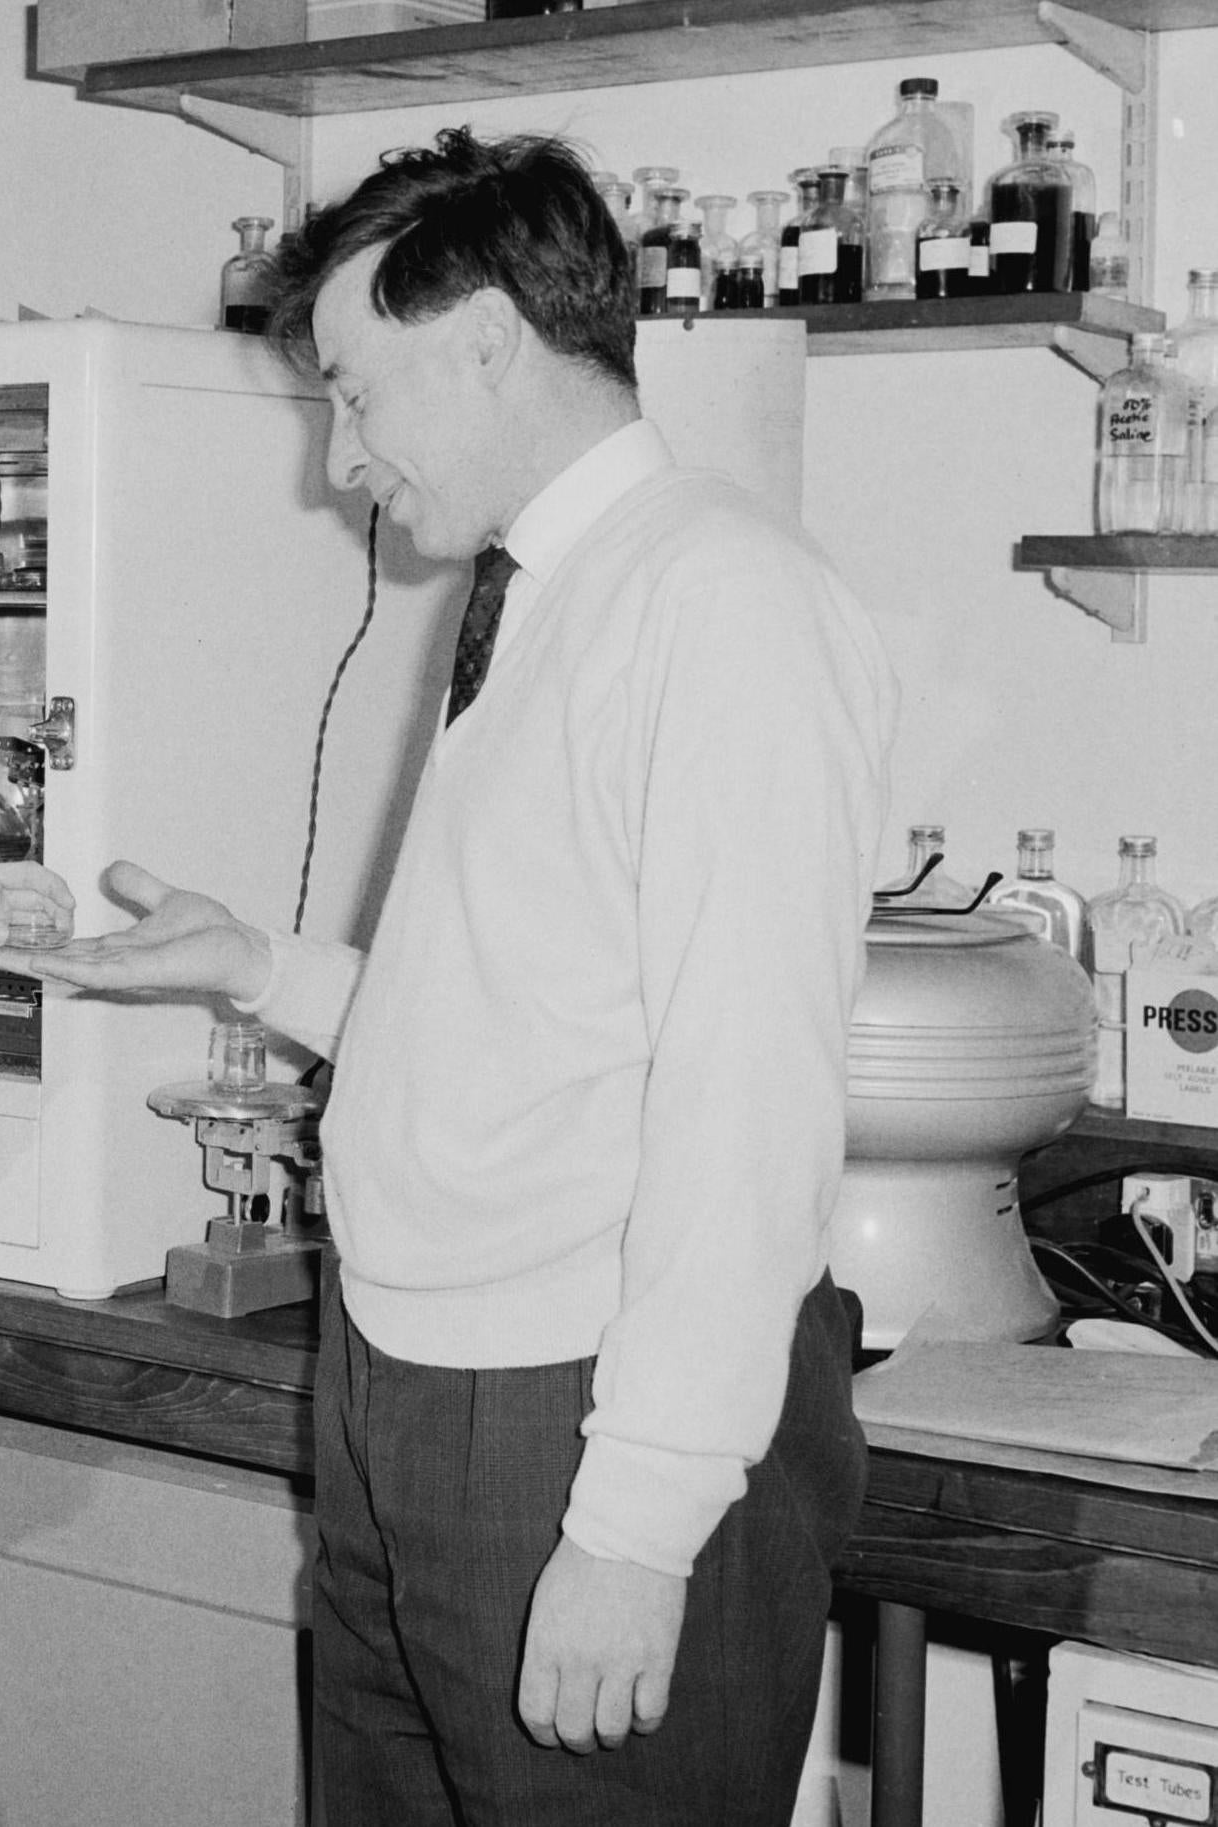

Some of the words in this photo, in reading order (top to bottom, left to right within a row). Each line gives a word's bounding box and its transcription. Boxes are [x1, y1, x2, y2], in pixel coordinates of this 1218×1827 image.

[1110, 427, 1155, 443] Saline
[1143, 1005, 1218, 1034] PRESS
[1117, 1769, 1150, 1789] Test
[1160, 1777, 1202, 1801] Tubes
